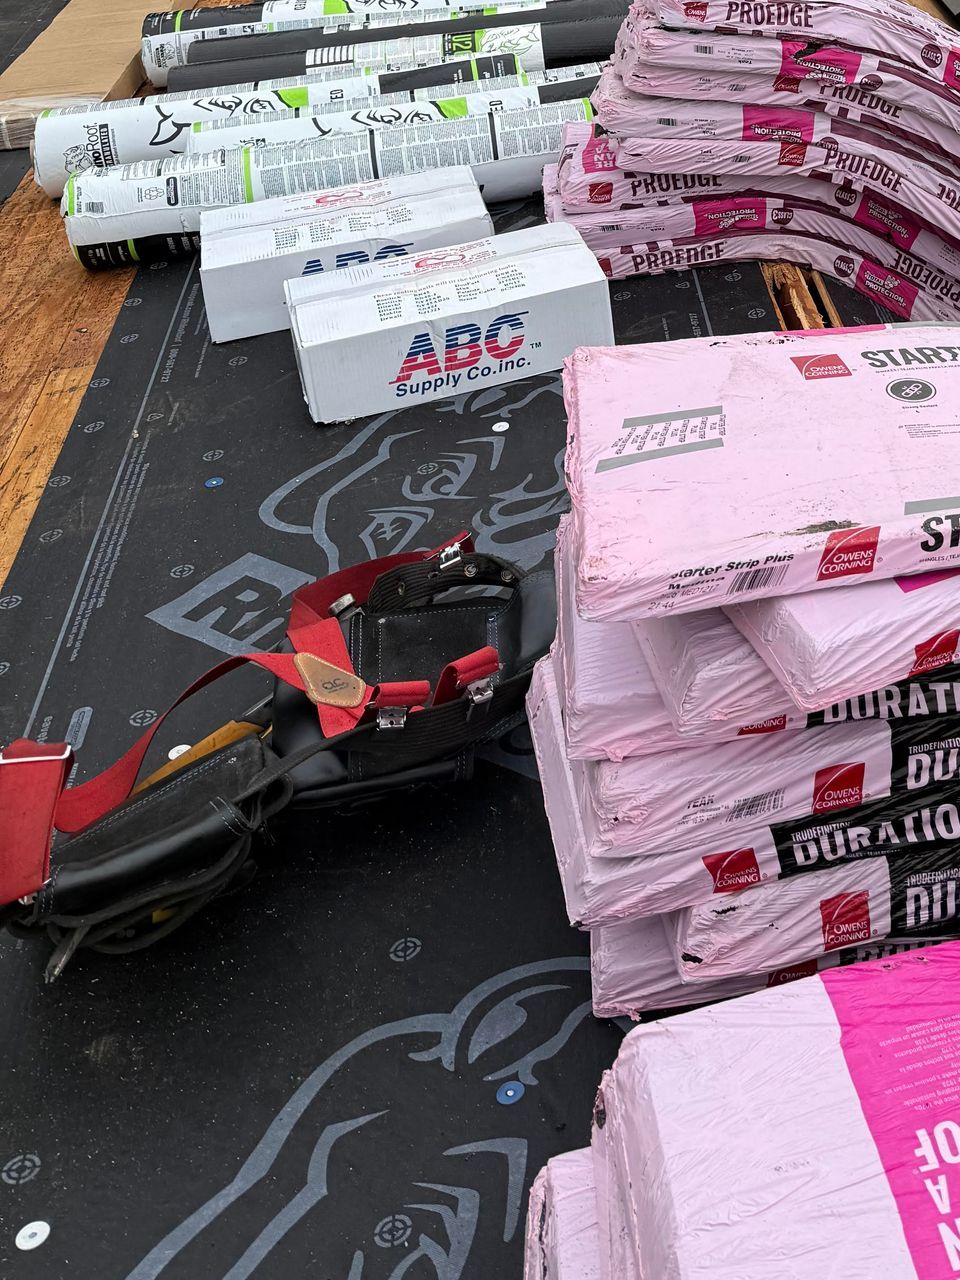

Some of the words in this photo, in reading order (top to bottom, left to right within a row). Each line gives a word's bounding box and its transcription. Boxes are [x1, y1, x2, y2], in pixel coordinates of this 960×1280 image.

[726, 2, 814, 28] PROEDGE
[824, 150, 902, 193] PROEDGE
[869, 208, 906, 235] PROTECTION
[865, 281, 904, 305] PROTECTION
[388, 311, 529, 384] ABC
[804, 369, 849, 378] CORNING
[809, 364, 846, 372] OWENS
[395, 373, 461, 397] Supply
[724, 558, 759, 572] Strip
[764, 552, 795, 564] Plus
[833, 549, 873, 562] OWENS
[821, 558, 872, 574] CORNING
[824, 786, 860, 801] OWENS
[791, 820, 853, 843] TRUDEFINITION
[716, 873, 760, 889] CORNING
[825, 930, 869, 945] CORNING
[833, 921, 868, 934] OWENS
[923, 1174, 951, 1214] A
